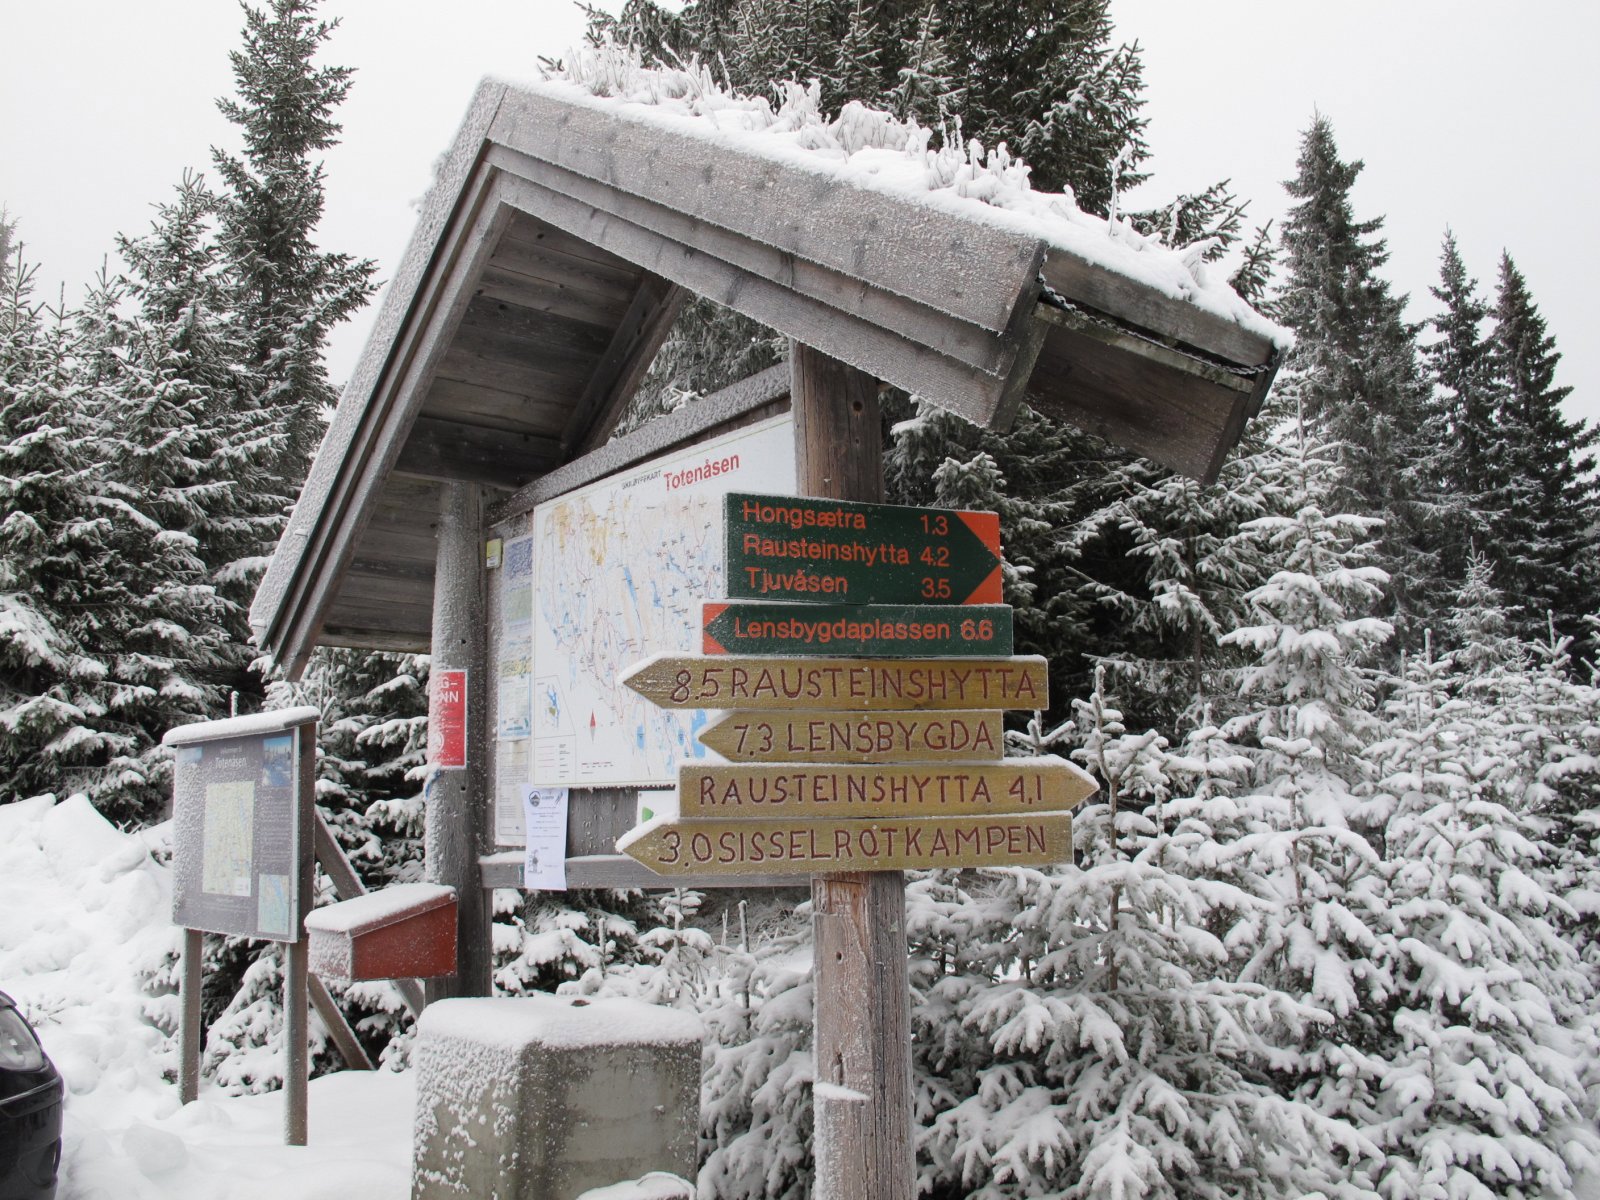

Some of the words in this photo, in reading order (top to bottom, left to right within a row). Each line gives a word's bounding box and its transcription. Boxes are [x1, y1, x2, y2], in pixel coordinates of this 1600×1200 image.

[664, 454, 740, 491] Totenåsen
[743, 501, 866, 529] Hongsætra
[920, 514, 949, 536] 1.3
[743, 533, 910, 567] Rausteinshytta
[920, 546, 950, 567] 4.2
[744, 567, 848, 593] Tjuvåsen
[921, 577, 951, 599] 3.5
[734, 616, 950, 643] Lensbygdaplassen
[960, 619, 994, 641] 6.6
[670, 668, 724, 703] 8.5
[731, 667, 1038, 701] RAUSTEINSHYTTA
[733, 723, 774, 758] 7.3
[787, 720, 995, 753] LENSBYGDA
[699, 774, 991, 805] RAUSTEINSHYTTA
[1008, 774, 1043, 804] 4.1
[658, 831, 714, 869] 3.0
